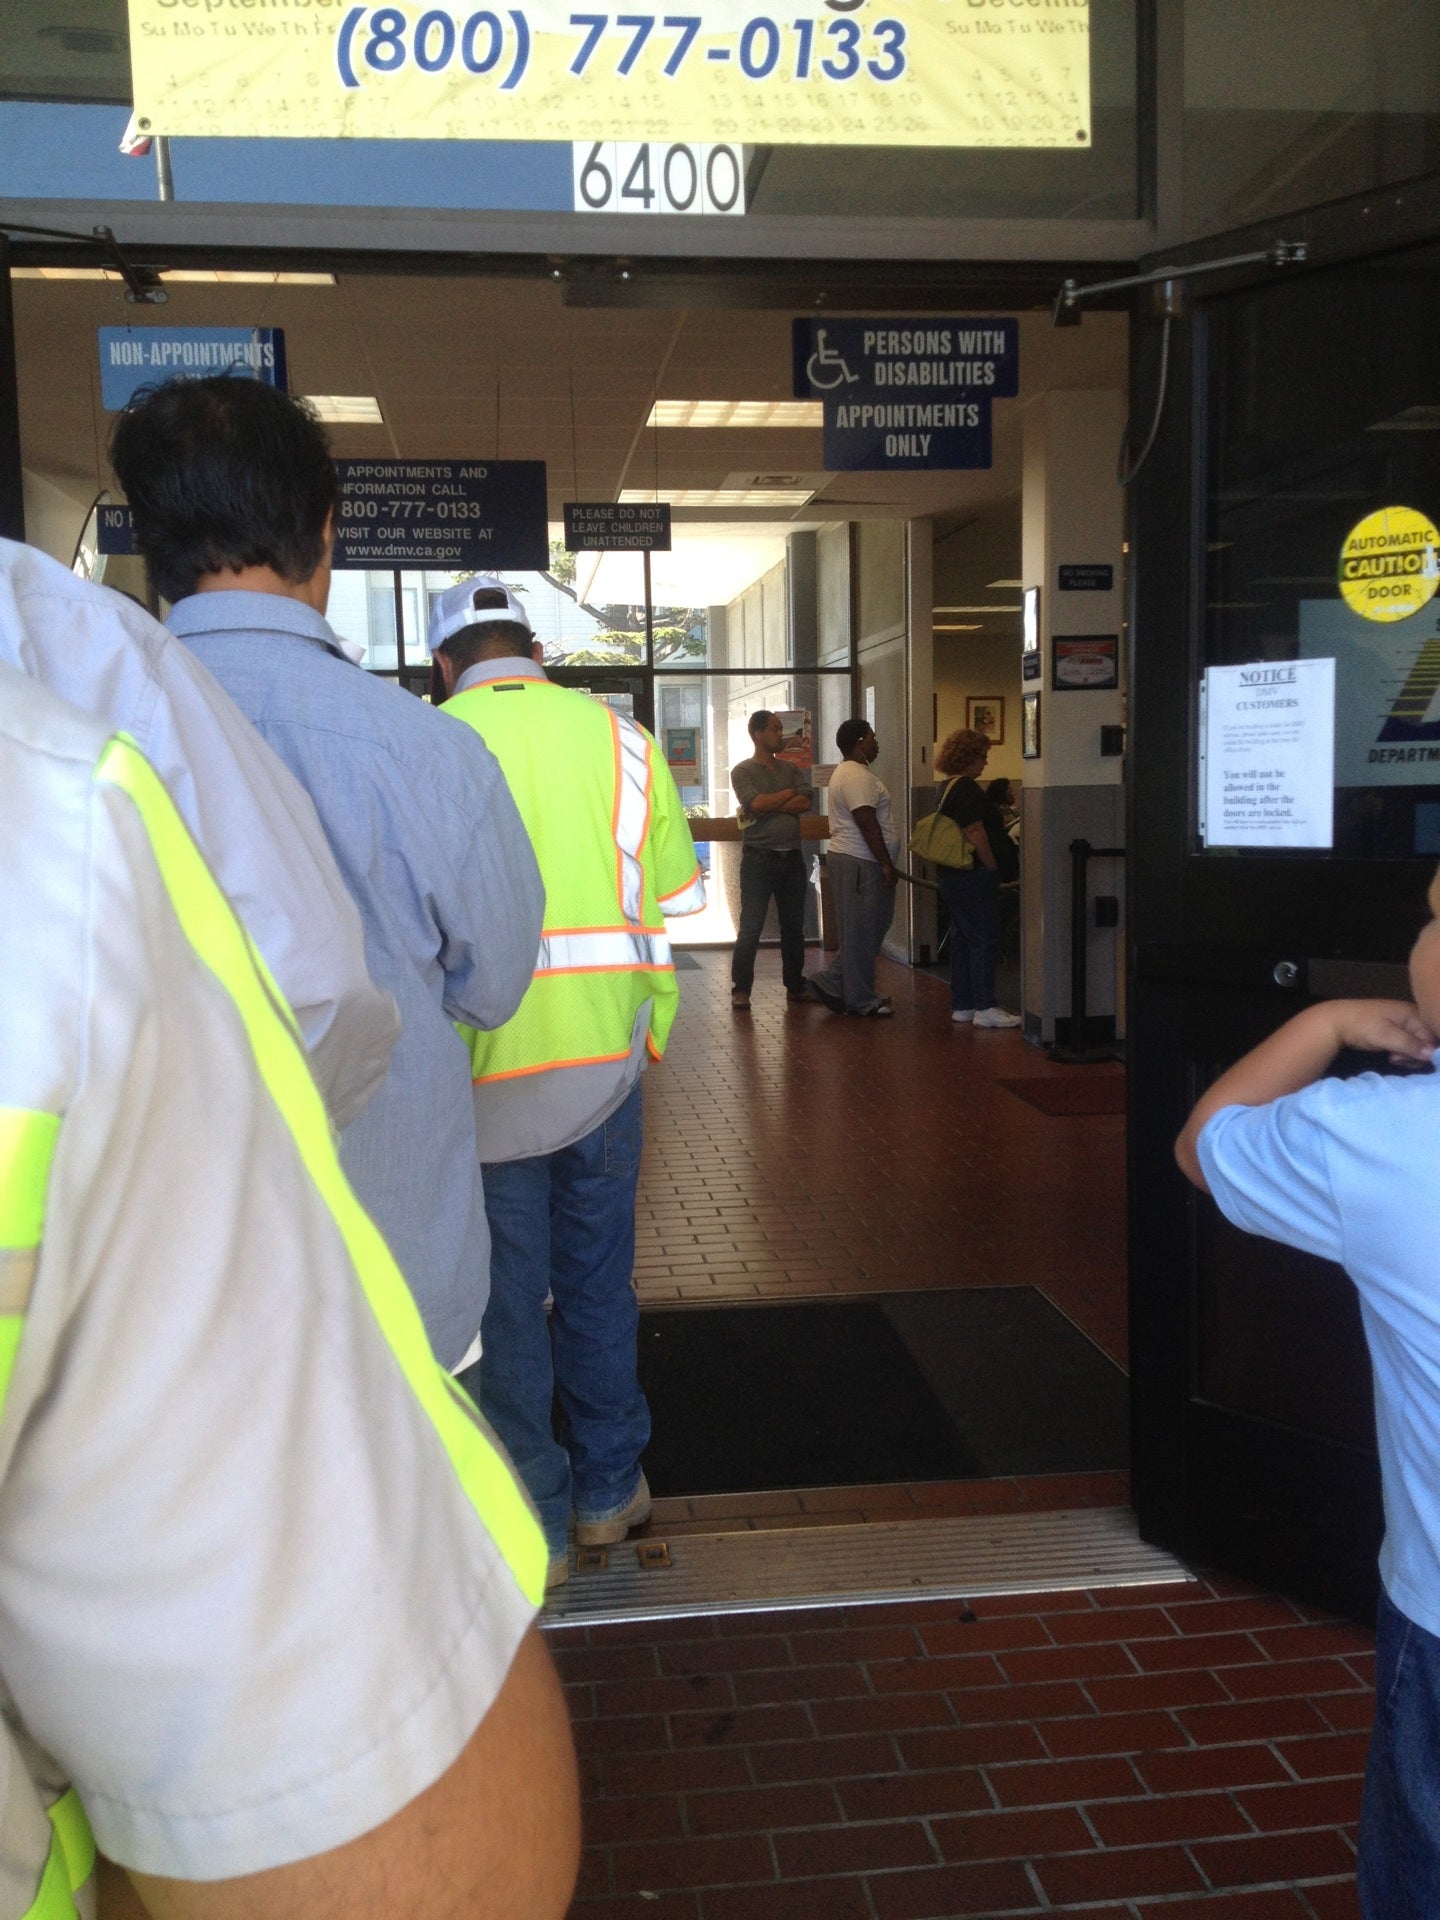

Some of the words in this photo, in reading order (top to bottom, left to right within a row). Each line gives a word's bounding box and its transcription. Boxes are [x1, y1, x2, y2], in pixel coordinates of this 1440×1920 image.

[140, 21, 166, 36] Su
[944, 20, 970, 34] Su
[337, 7, 531, 89] (800)
[569, 14, 906, 81] 777-0133
[579, 141, 740, 211] 6400
[863, 330, 952, 355] PERSONS
[958, 330, 1005, 355] WITH
[109, 341, 275, 368] NON-APPOINTMENTS
[874, 361, 996, 386] DISABILITIES
[836, 404, 980, 428] APPOINTMENTS
[885, 434, 932, 457] ONLY
[346, 465, 453, 479] APPOINTMENTS
[459, 466, 488, 479] AND
[342, 483, 426, 495] FORMATION
[431, 484, 467, 496] CALL
[104, 510, 123, 528] NO
[572, 508, 615, 519] PLEASE
[619, 508, 635, 519] DO
[639, 508, 661, 519] NOT
[337, 527, 371, 539] VISIT
[377, 528, 406, 539] OUR
[412, 528, 472, 540] WEBSITE
[478, 528, 495, 540] AT
[571, 522, 606, 533] LEAVE
[610, 522, 663, 533] CHILDREN
[583, 536, 653, 546] UNATTENDED
[1348, 530, 1433, 552] AUTOMATIC
[345, 544, 462, 559] www.dmv.ca.gov
[1367, 583, 1412, 600] DOOR
[1239, 667, 1297, 687] NOTICE
[1236, 698, 1299, 711] CUSTOMERS
